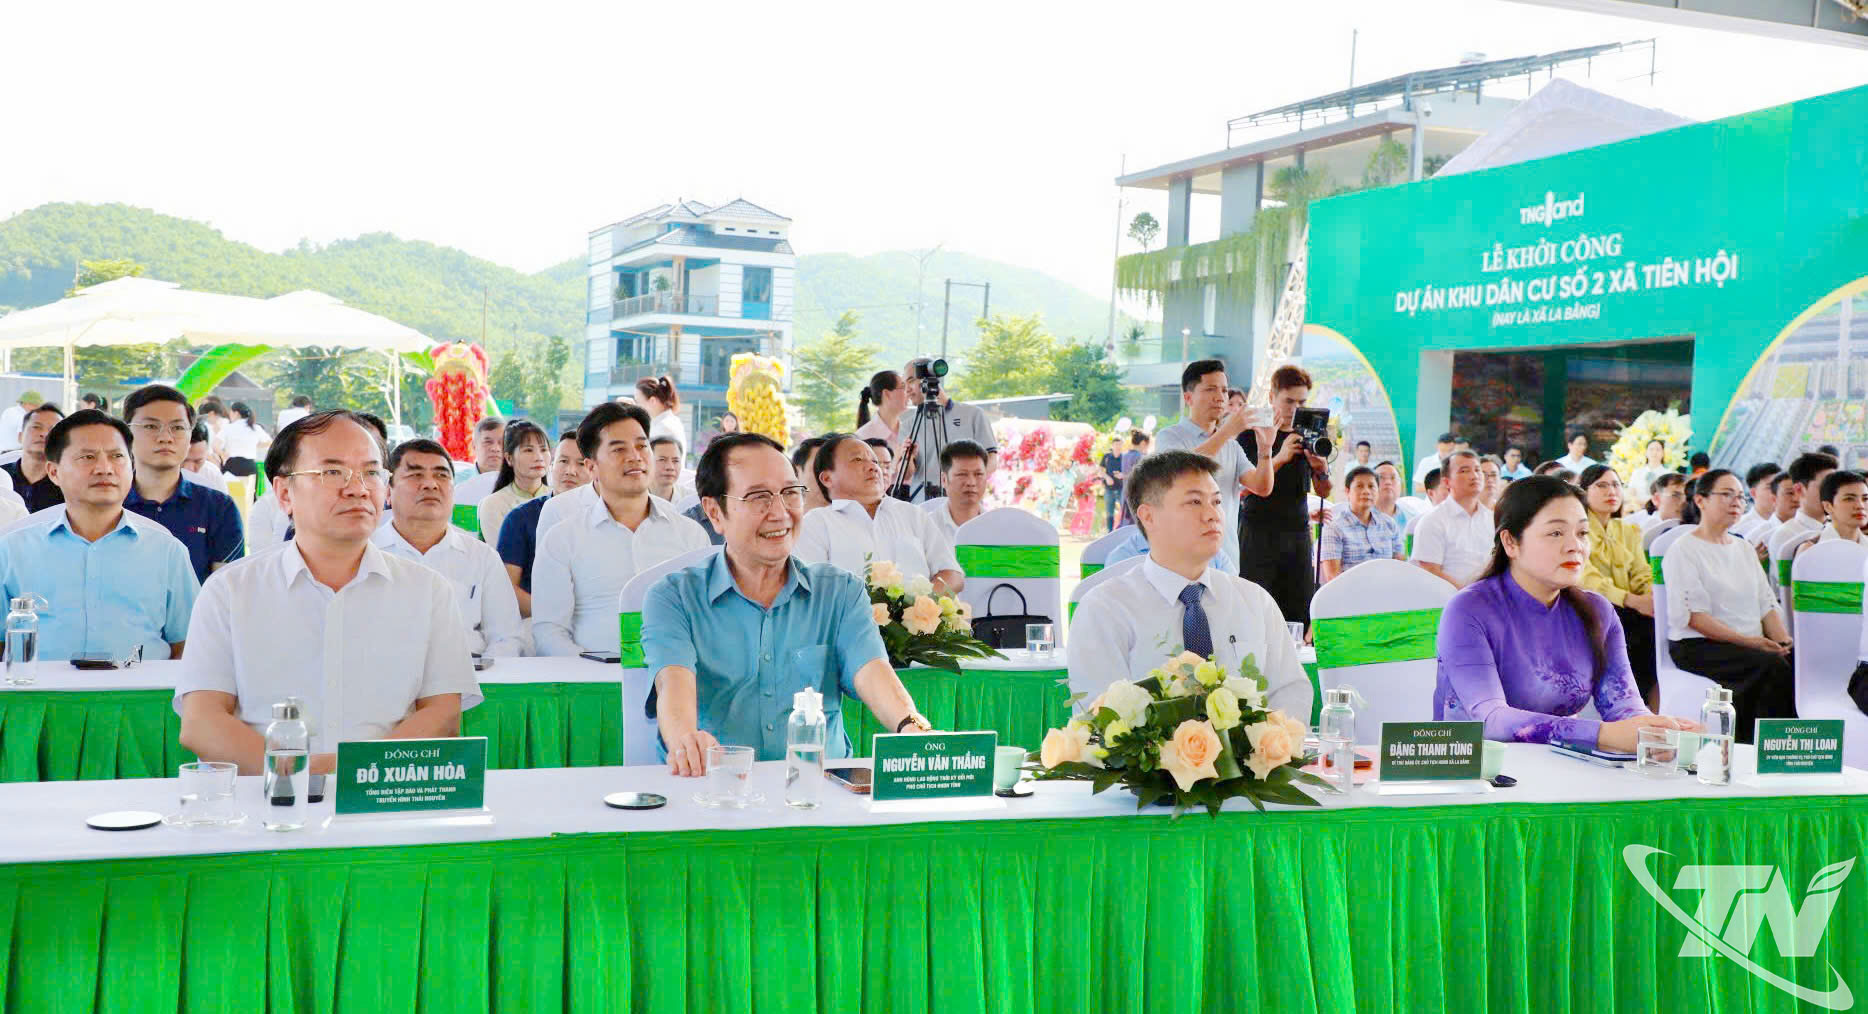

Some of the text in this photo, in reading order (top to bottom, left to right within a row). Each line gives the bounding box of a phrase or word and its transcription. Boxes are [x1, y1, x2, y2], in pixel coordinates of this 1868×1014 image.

[1482, 234, 1622, 272] LỄ KHỞI CÔNG
[1395, 249, 1738, 316] DỰ ÁN KHU DÂN CƯ SỐ 2 XÃ TIÊN HỘI
[1517, 308, 1528, 324] LÀ
[1531, 306, 1547, 322] XÃ
[1548, 307, 1562, 321] LA
[924, 742, 946, 750] ÔNG
[1390, 741, 1472, 758] ĐẶNG THANH TÙNG
[1764, 735, 1837, 753] NGUYỄN THỊ LOAN
[384, 748, 440, 759] ĐỒNG CHÍ
[883, 751, 986, 772] NGUYỄN VĂN THẮNG
[356, 762, 466, 783] ĐỖ XUÂN HÒA
